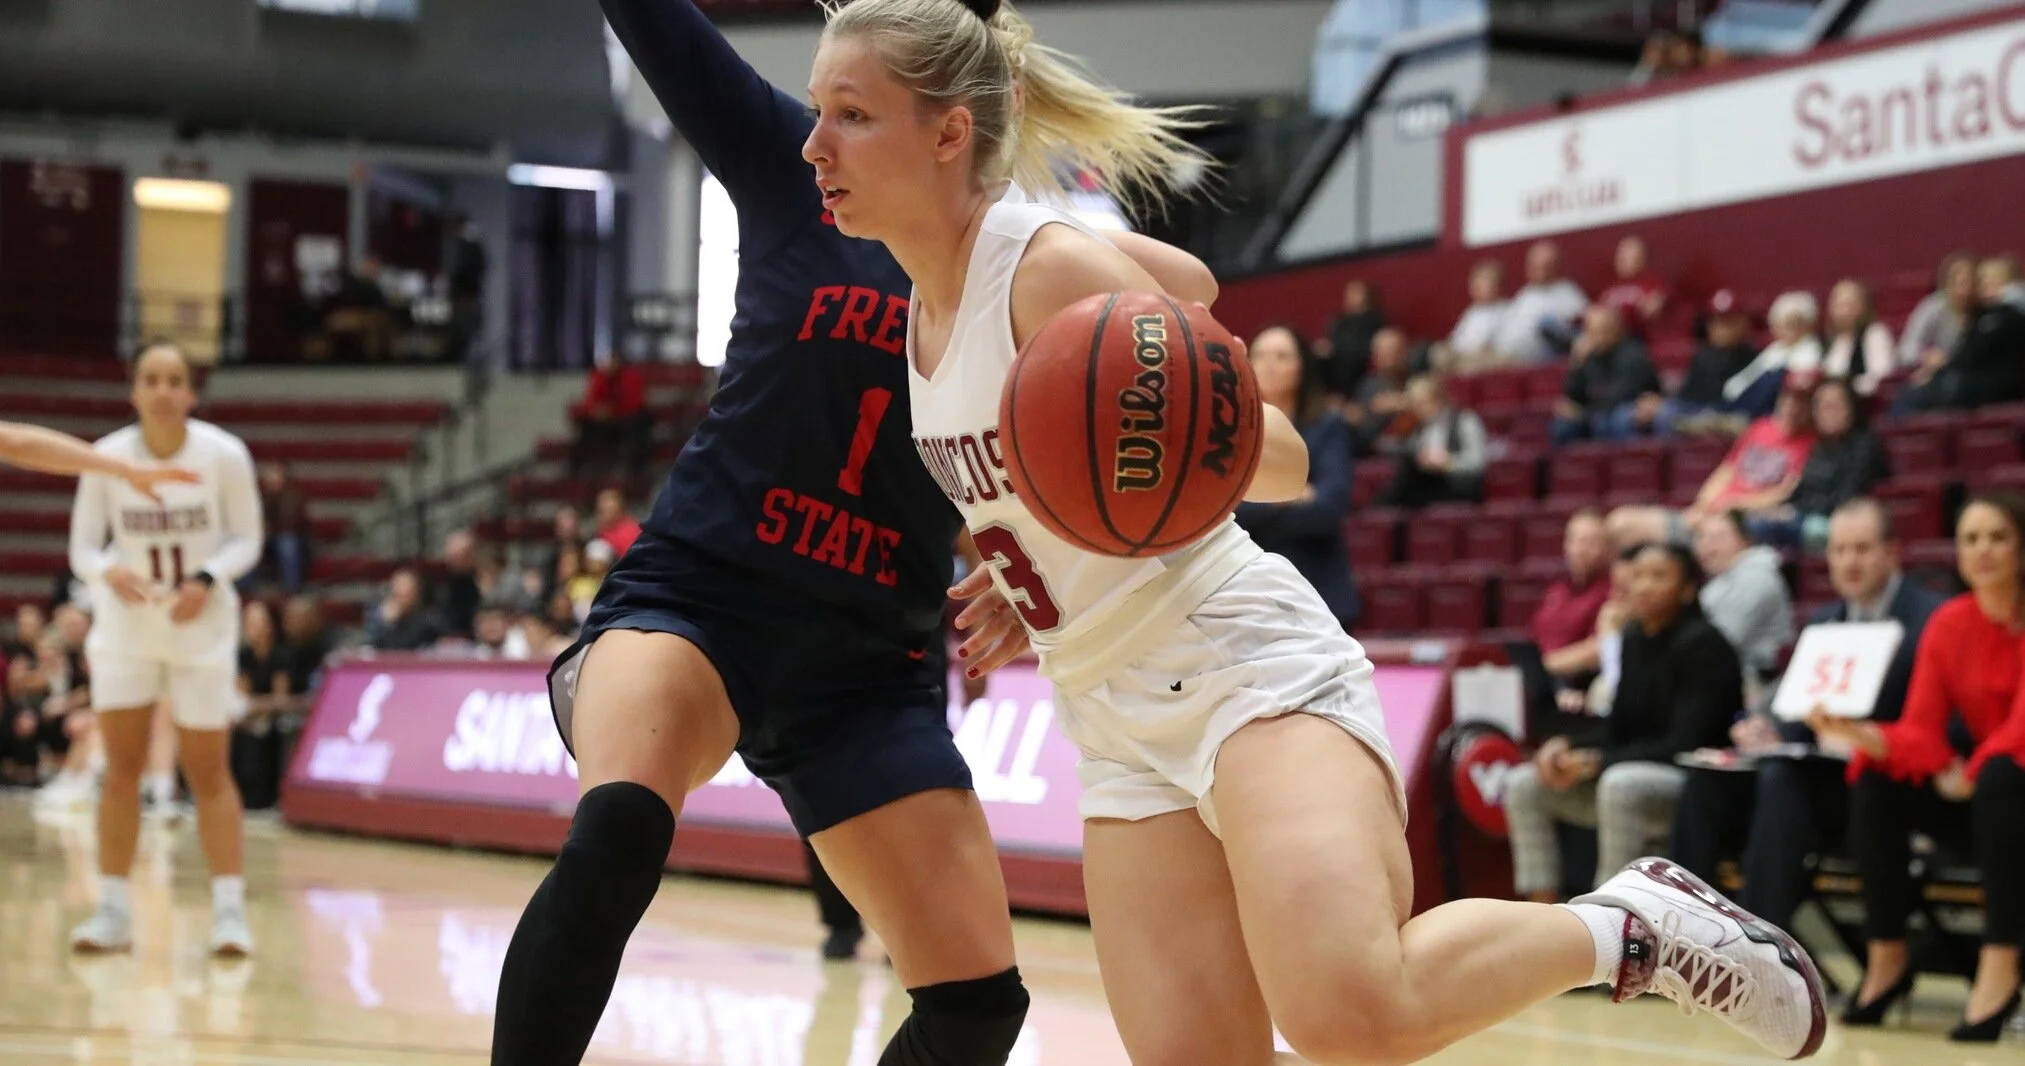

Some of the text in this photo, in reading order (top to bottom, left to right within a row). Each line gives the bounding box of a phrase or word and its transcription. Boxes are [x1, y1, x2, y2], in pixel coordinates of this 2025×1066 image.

[838, 387, 892, 496] 1
[1113, 313, 1168, 493] Wilson
[1201, 341, 1240, 478] NCAA
[149, 545, 185, 589] 11
[756, 487, 902, 586] STATE
[1629, 943, 1640, 955] 13
